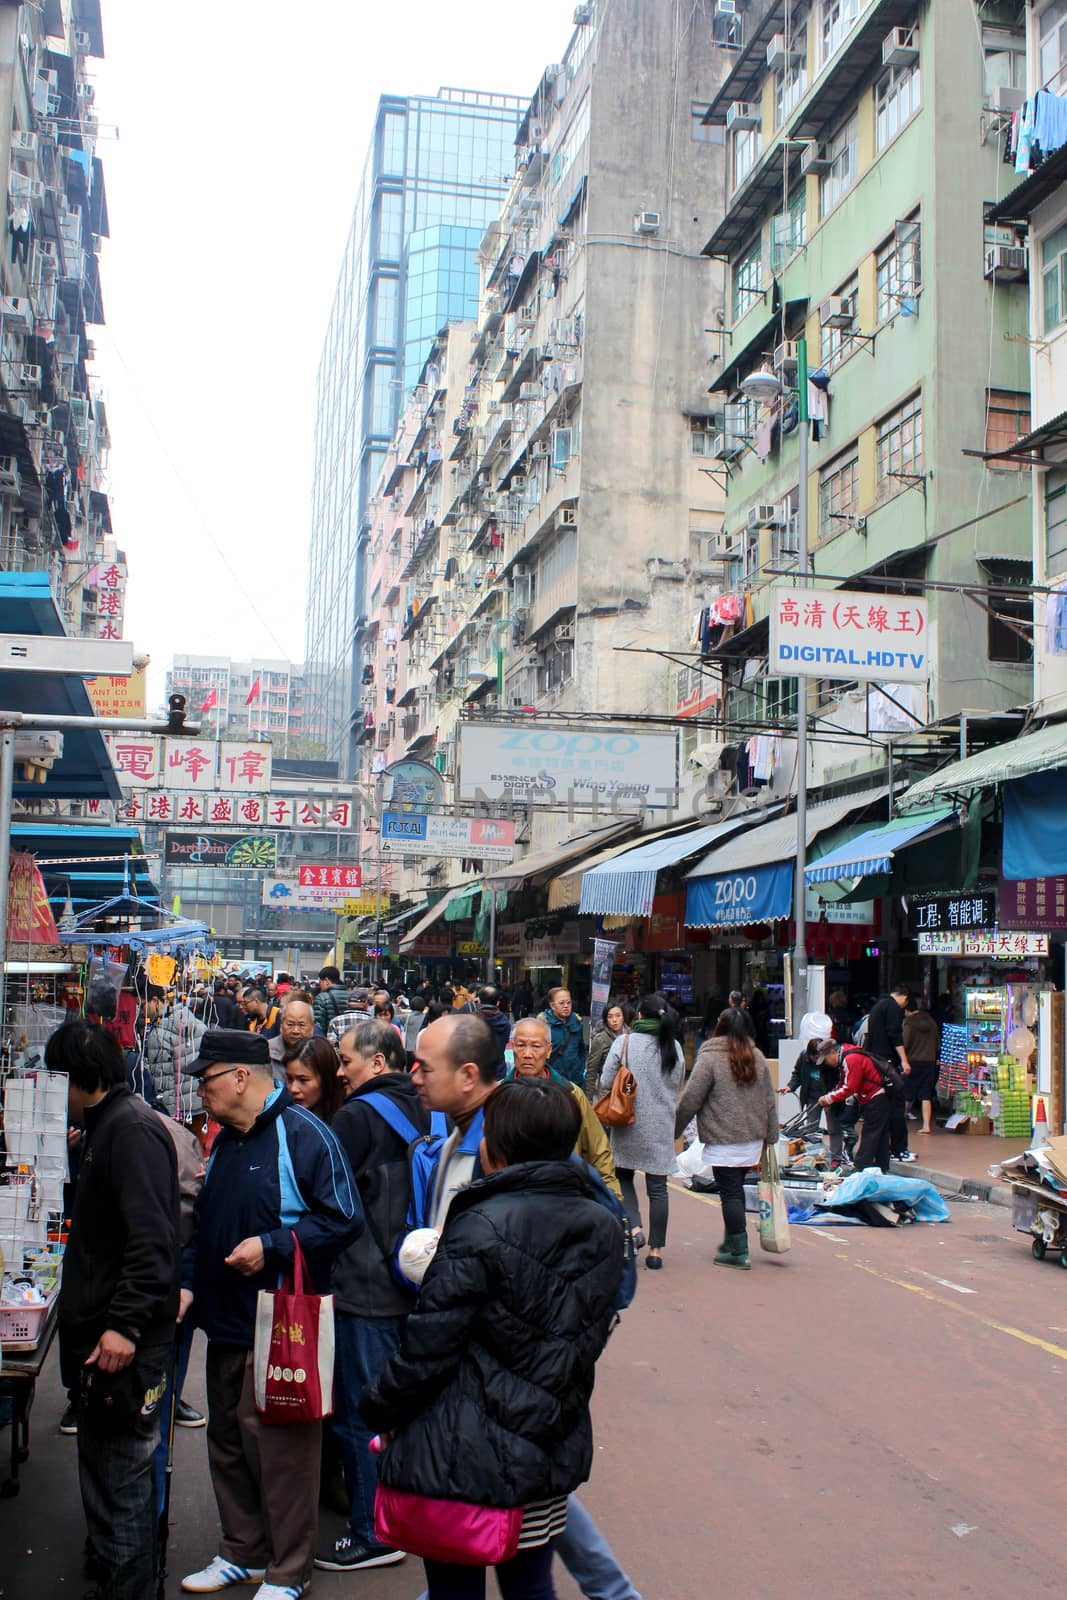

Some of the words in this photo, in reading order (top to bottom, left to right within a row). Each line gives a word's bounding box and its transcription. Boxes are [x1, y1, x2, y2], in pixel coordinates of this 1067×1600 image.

[779, 598, 925, 637] 高清(天線王)
[779, 644, 924, 669] DIGITAL.HDTV
